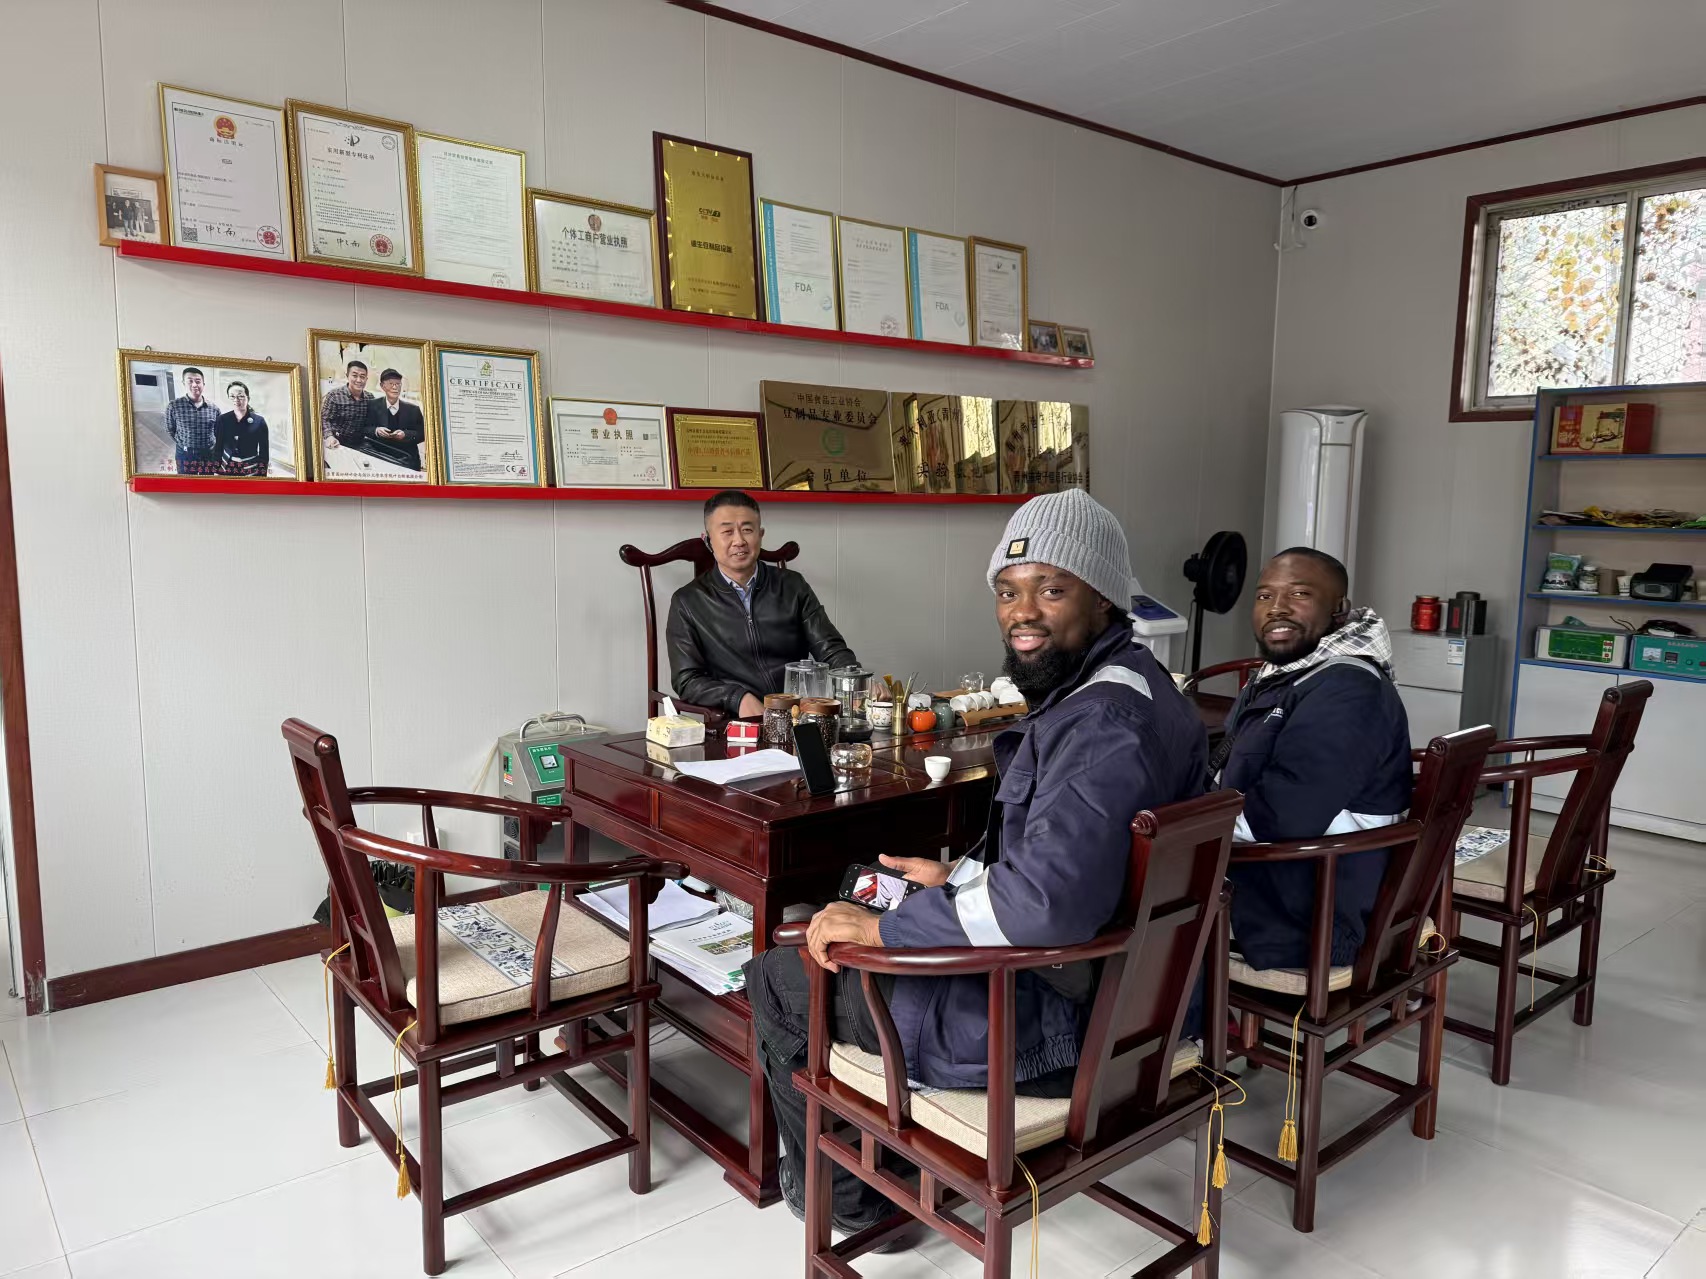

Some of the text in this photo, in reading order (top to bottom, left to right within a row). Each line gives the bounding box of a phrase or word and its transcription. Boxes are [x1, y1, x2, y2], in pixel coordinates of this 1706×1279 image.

[561, 226, 629, 249] 个体工商户营业执照
[794, 281, 813, 293] FDA
[935, 301, 950, 312] FDA
[449, 377, 523, 390] CERTIFICATE
[590, 427, 634, 441] 营业执照
